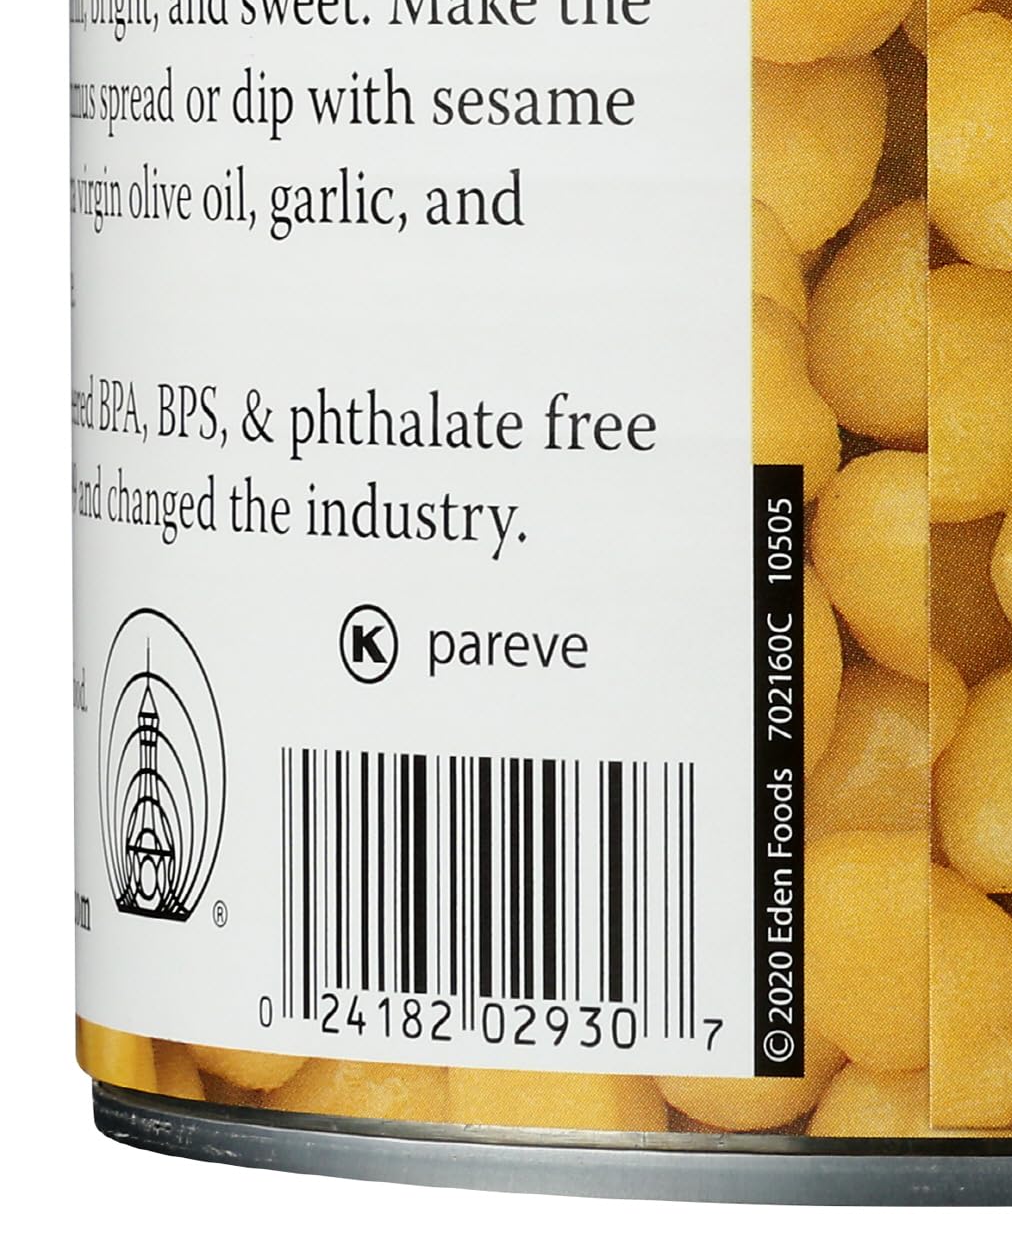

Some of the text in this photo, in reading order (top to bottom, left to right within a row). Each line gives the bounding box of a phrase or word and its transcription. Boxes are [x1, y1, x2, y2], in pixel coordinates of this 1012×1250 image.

[99, 65, 175, 138] spread
[186, 85, 222, 124] or
[232, 66, 294, 142] dip
[306, 67, 416, 126] with
[432, 87, 636, 126] sesame
[77, 163, 123, 234] virgin
[128, 162, 192, 221] olive
[202, 164, 257, 231] oil,
[269, 166, 408, 242] garlic,
[425, 167, 526, 227] and
[98, 378, 148, 444] BPA,
[157, 383, 228, 449] BPS,
[241, 388, 275, 444] &
[289, 386, 524, 462] phthalate
[543, 391, 657, 452] free
[78, 464, 103, 522] and
[107, 467, 217, 546] changed
[228, 475, 291, 536] the
[306, 480, 527, 562] industry.
[767, 498, 793, 584] 10505
[429, 629, 589, 678] pareve
[766, 613, 793, 741] 702160C
[766, 768, 793, 858] Foods
[766, 868, 793, 943] Eden
[320, 993, 453, 1043] 24182
[481, 1002, 638, 1050] 02930
[768, 951, 793, 1025] 2020
